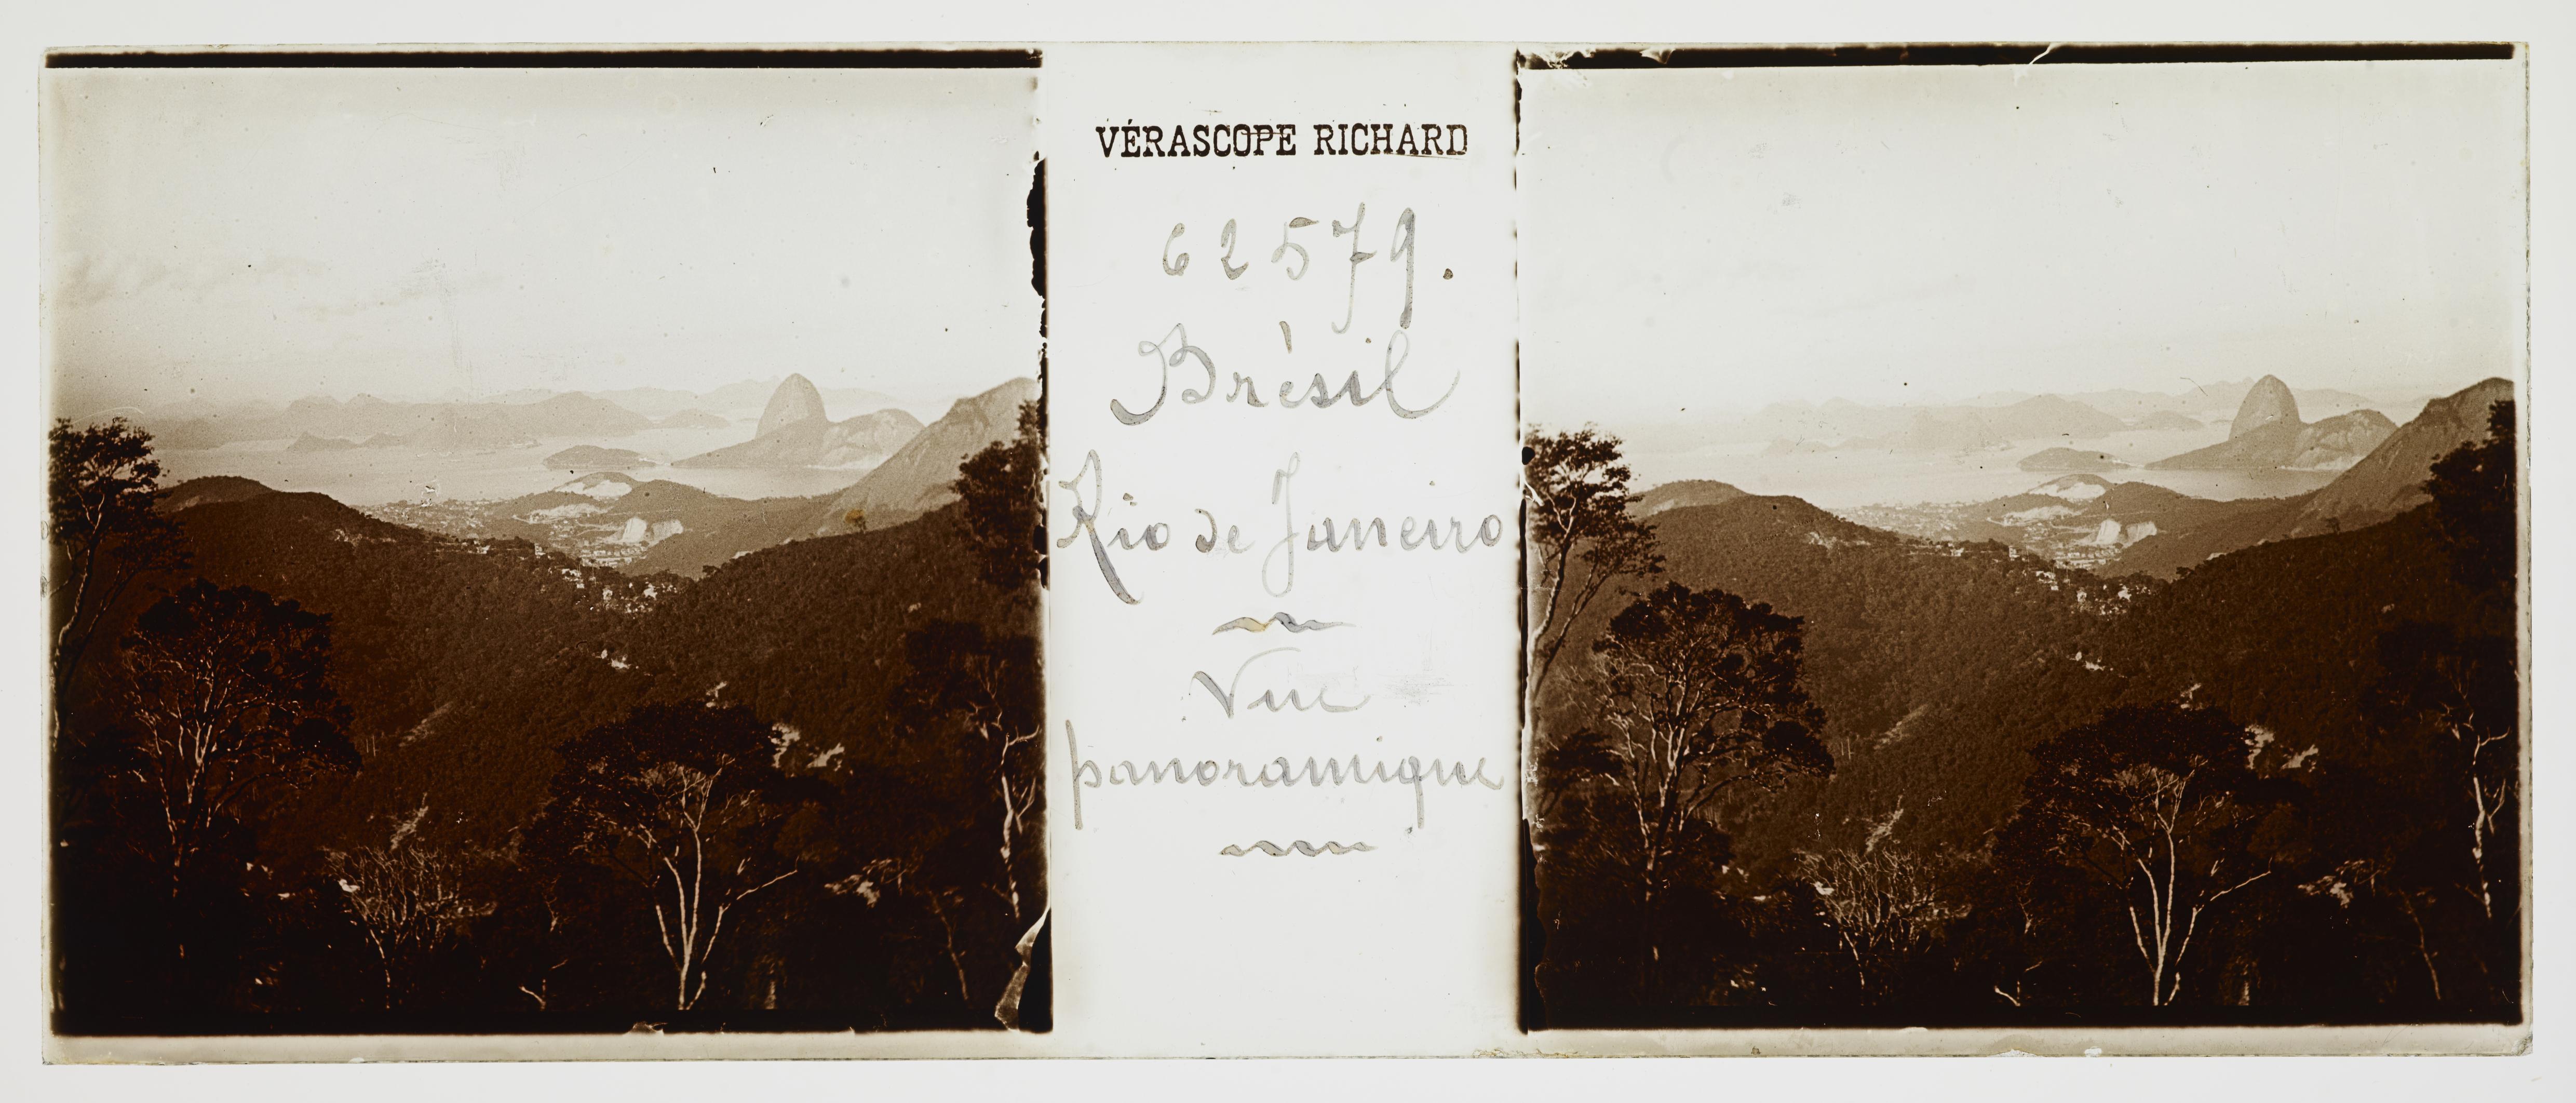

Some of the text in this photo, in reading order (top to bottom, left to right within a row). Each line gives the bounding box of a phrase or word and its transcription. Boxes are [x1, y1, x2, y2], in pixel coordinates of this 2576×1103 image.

[1095, 119, 1468, 158] VÉRASCOPE RICHARD
[1057, 449, 1504, 606] Rio de Janeiro
[1189, 647, 1371, 719] Vue
[1064, 719, 1505, 831] panoramique
